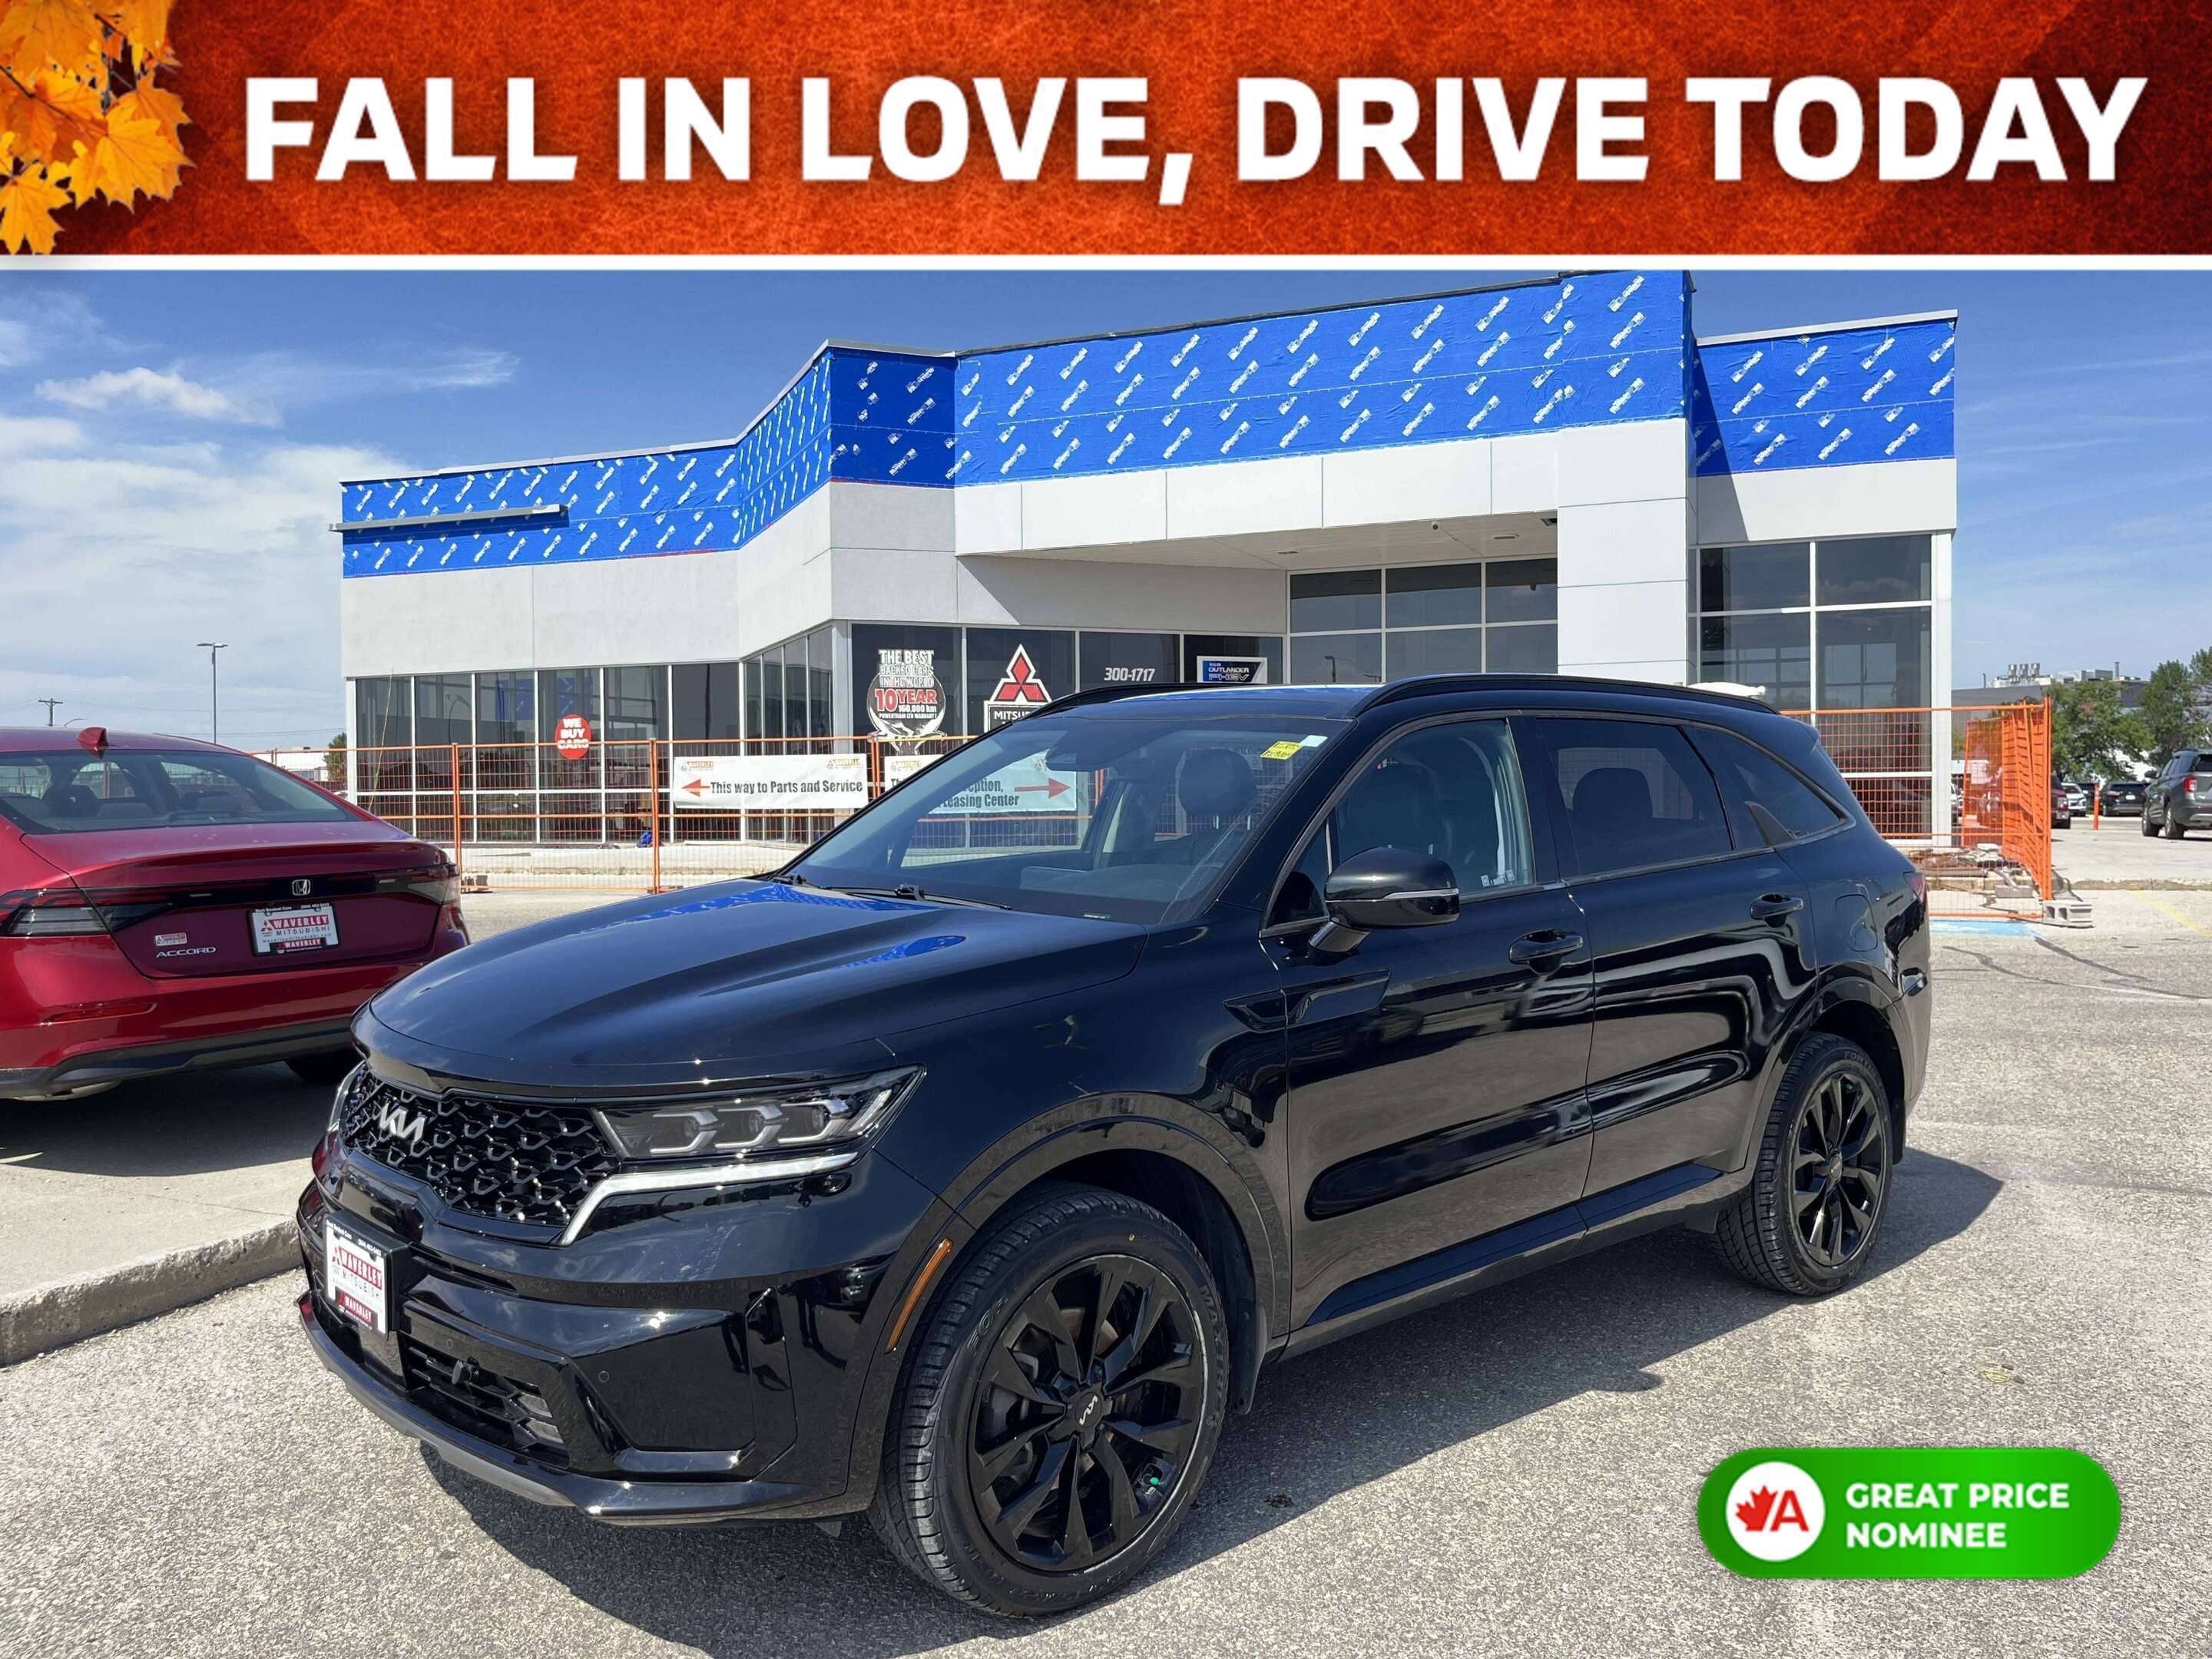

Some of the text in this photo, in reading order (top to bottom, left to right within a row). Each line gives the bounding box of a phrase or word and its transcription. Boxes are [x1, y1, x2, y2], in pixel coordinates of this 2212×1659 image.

[879, 650, 934, 665] THE BEST
[880, 664, 934, 676] BACKED CARS
[1104, 667, 1155, 682] 300-1717
[906, 676, 934, 687] WORLD
[1208, 673, 1250, 681] PHEV
[875, 689, 937, 713] 10 YEAR
[926, 704, 937, 713] km
[994, 710, 1031, 720] MITSU
[563, 718, 581, 728] WE
[561, 728, 585, 739] BUY
[558, 739, 589, 750] CARS
[710, 779, 863, 795] This way to Parts and Service
[984, 793, 1020, 806] Center
[273, 915, 328, 929] WAVERLEY
[276, 926, 330, 935] MITSUBISHI
[284, 939, 321, 949] WAVERLEY
[156, 946, 216, 958] ACCORD
[342, 1250, 382, 1288] WAVERLEY
[345, 1294, 373, 1323] WAVERLEY
